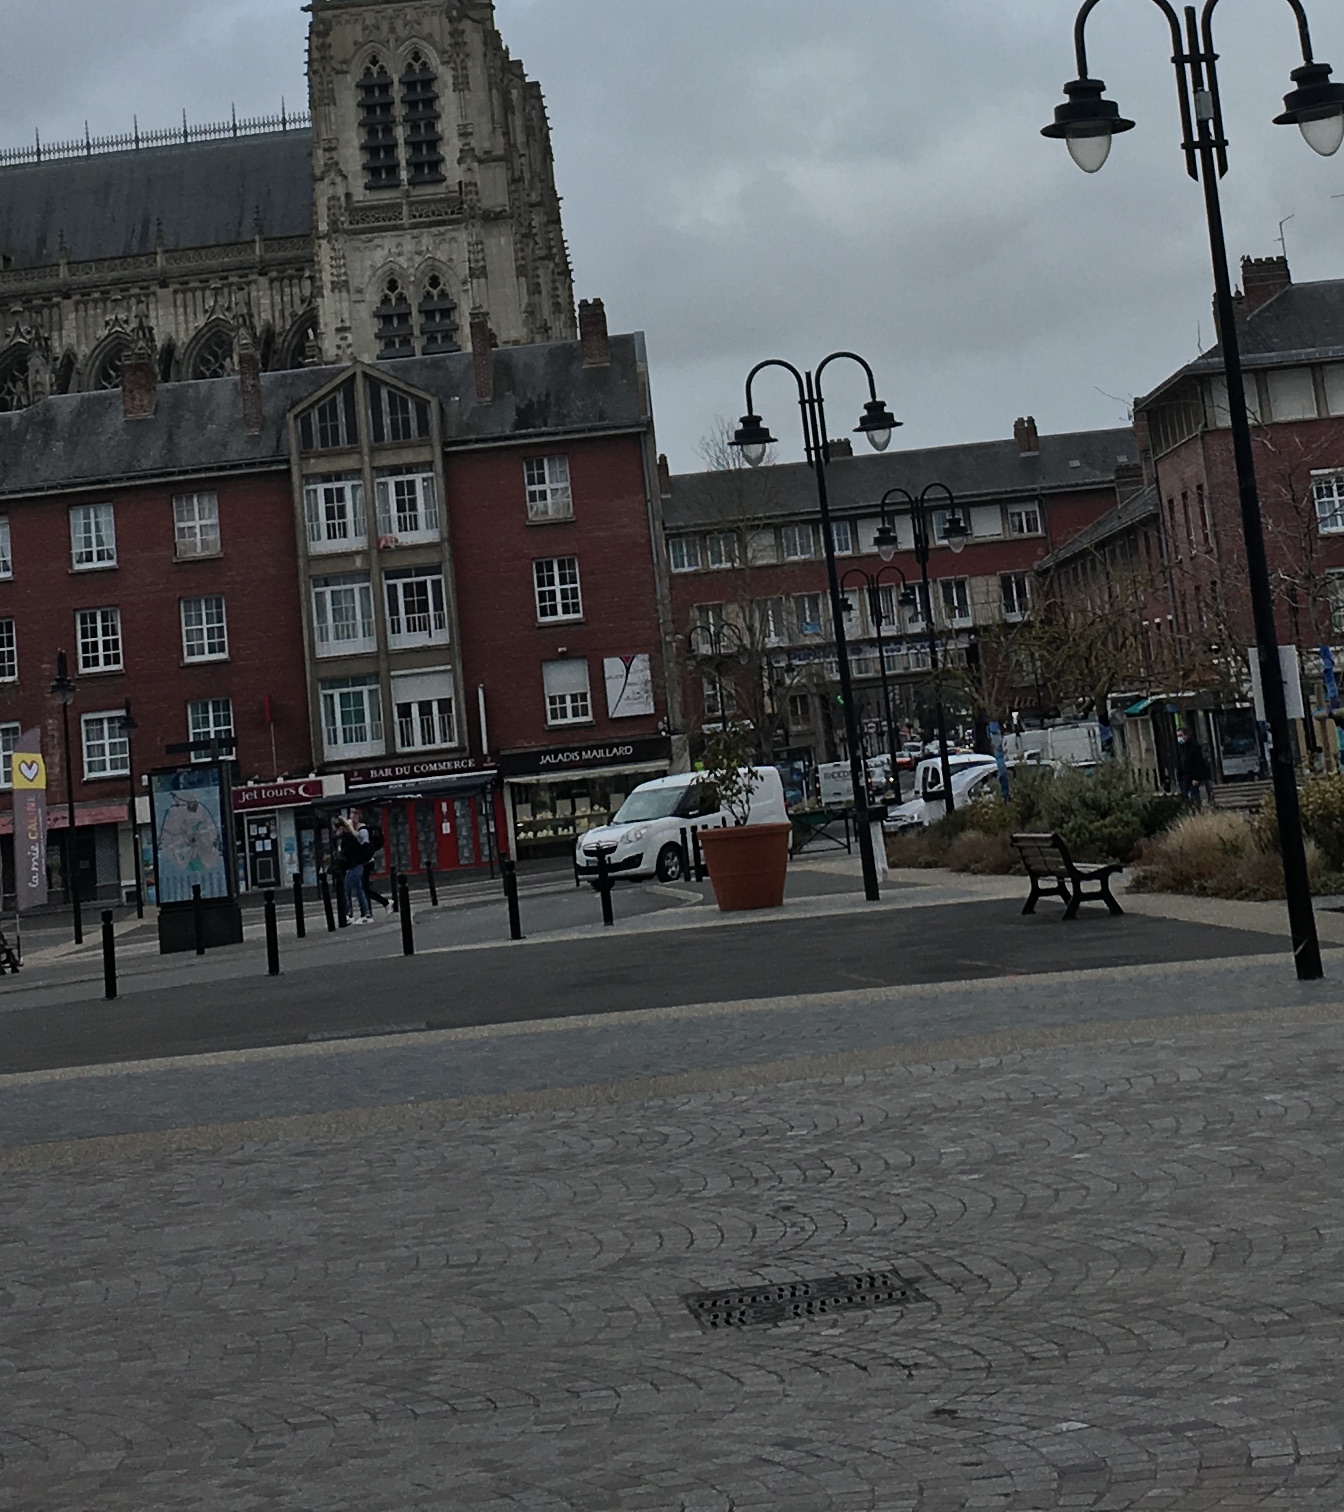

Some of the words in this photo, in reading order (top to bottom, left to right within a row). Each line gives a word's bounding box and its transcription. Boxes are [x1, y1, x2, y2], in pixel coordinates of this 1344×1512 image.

[538, 751, 581, 765] JALADIS
[581, 745, 634, 760] MAILLARD
[369, 767, 393, 778] BAR
[394, 765, 411, 776] DU
[413, 758, 476, 773] COMMERCE
[261, 786, 296, 799] tours
[26, 842, 40, 872] mie
